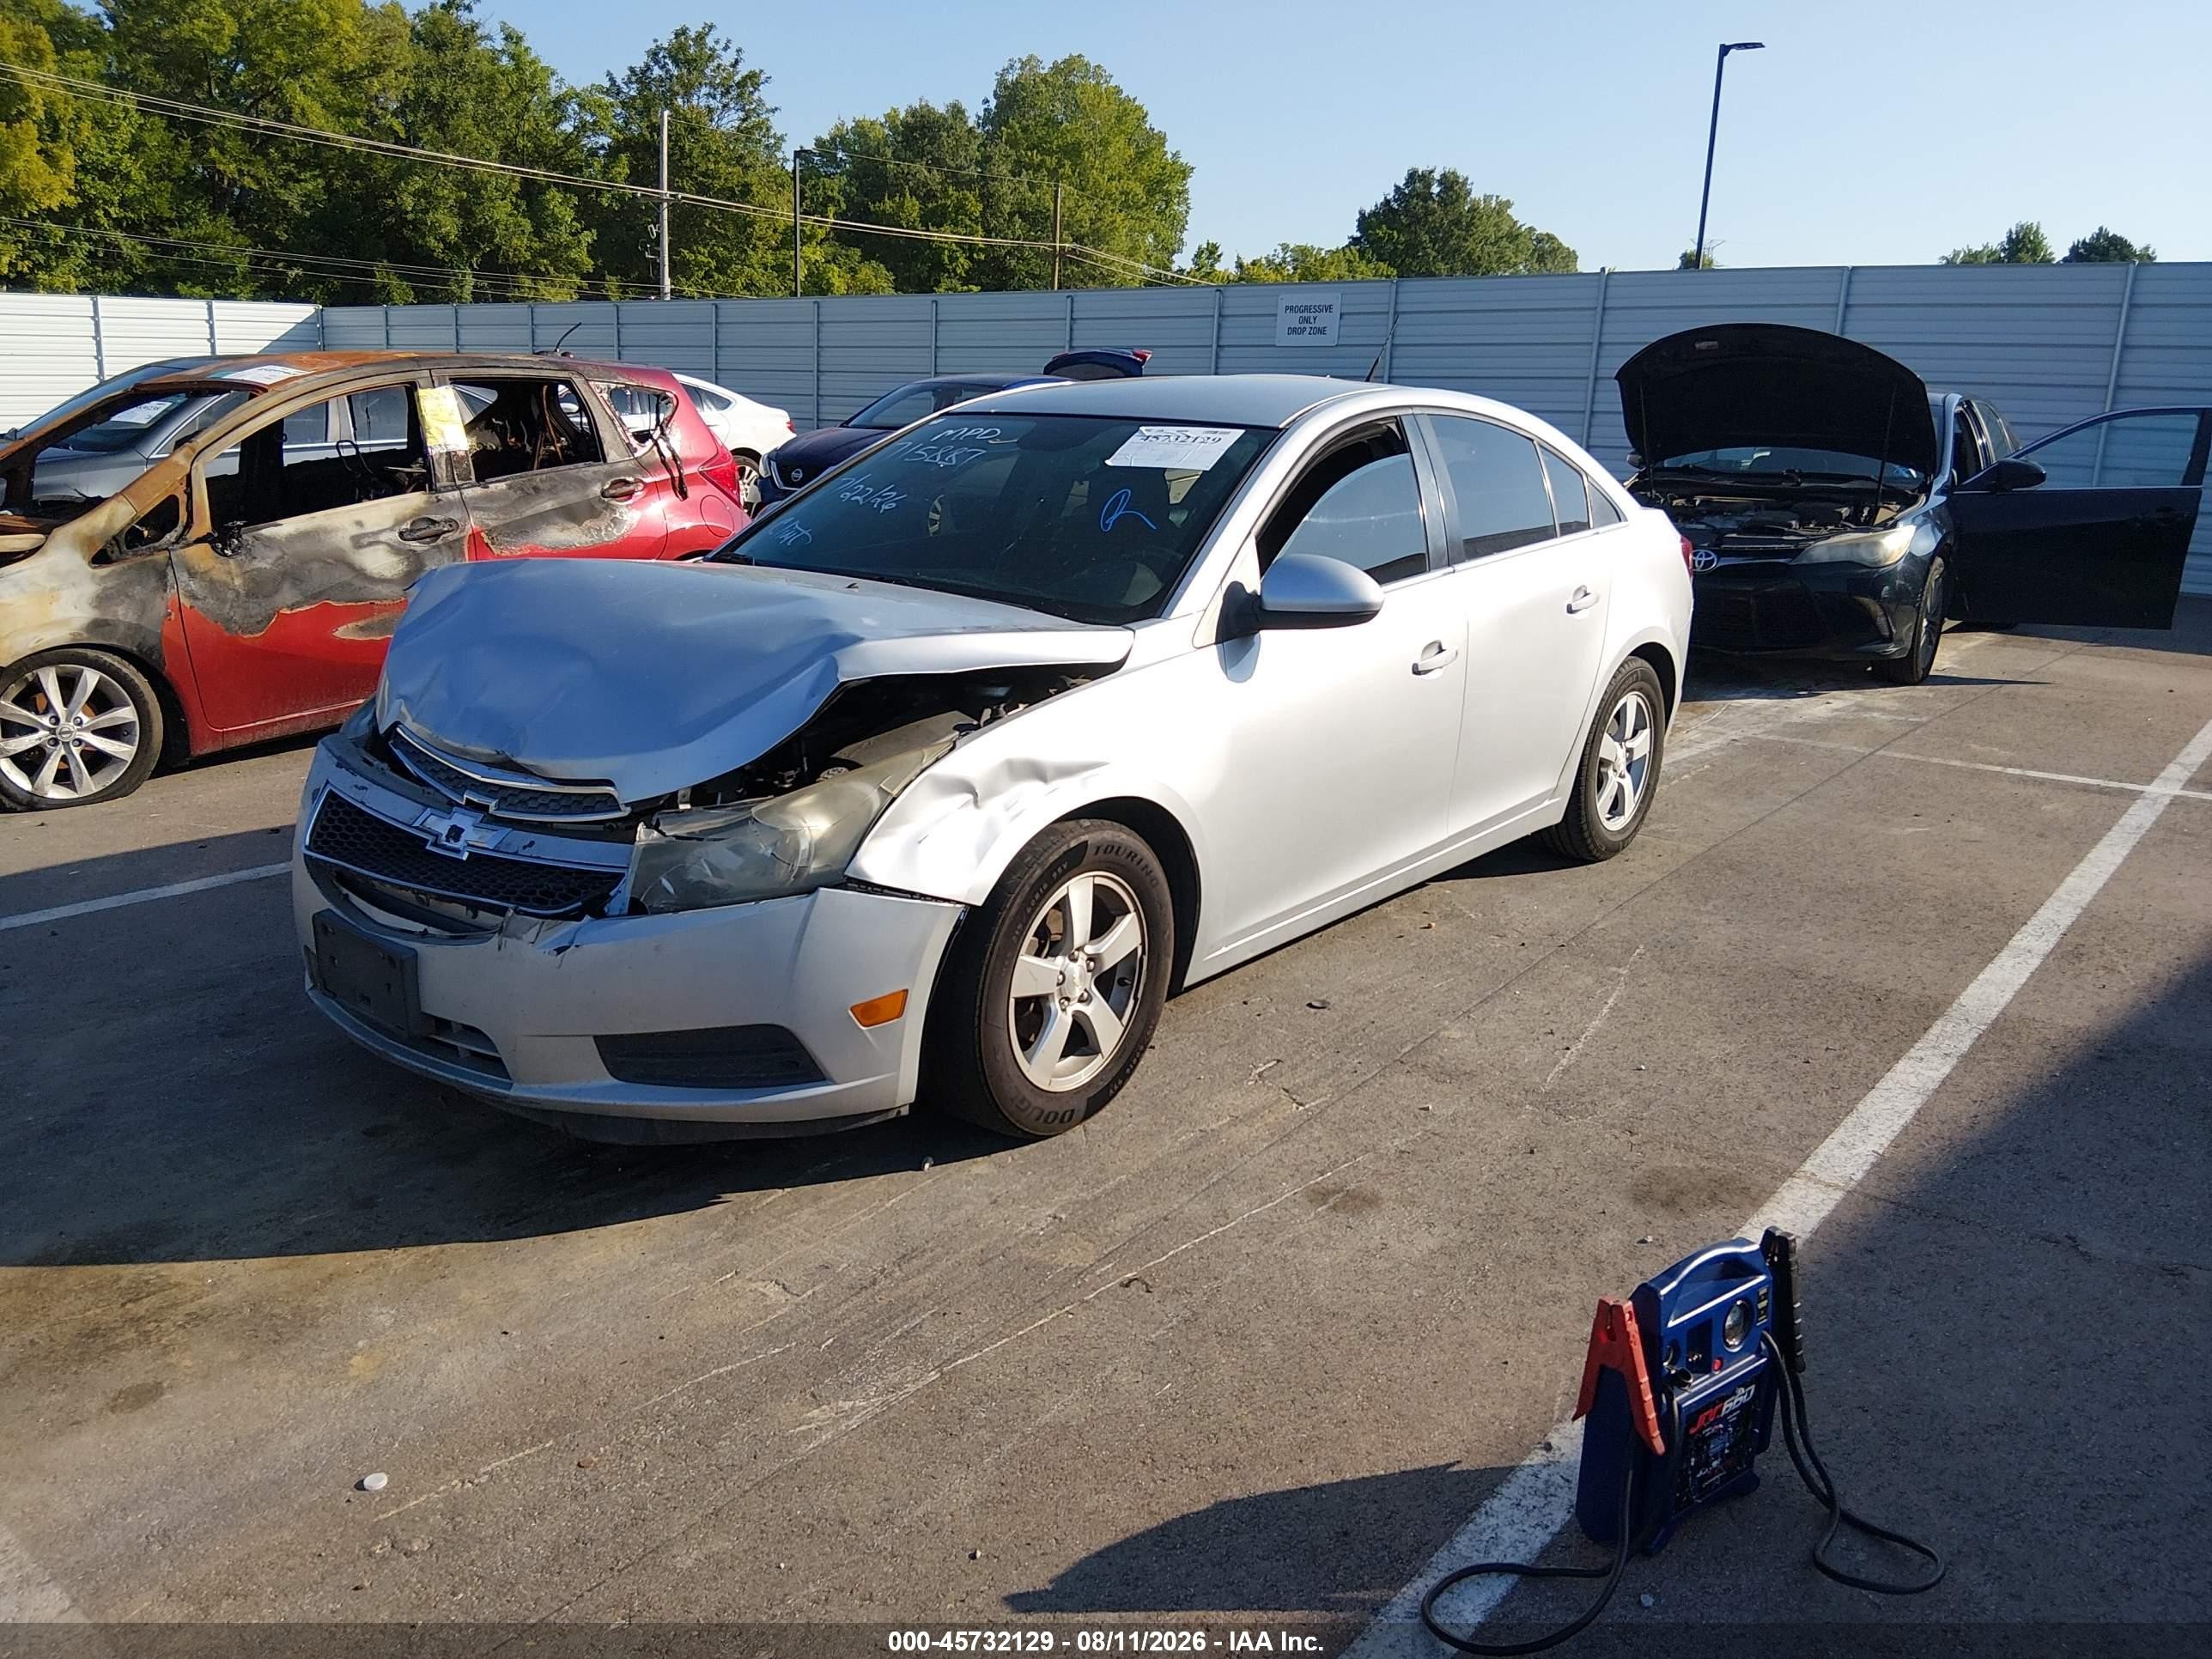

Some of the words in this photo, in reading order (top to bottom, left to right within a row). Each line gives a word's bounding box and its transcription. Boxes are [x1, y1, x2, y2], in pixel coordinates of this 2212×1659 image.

[1284, 304, 1334, 314] PROGRESSIVE
[1298, 315, 1317, 325] ONLY
[1287, 326, 1307, 336] DROP
[1308, 326, 1328, 336] ZONE
[1092, 843, 1159, 890] TOURING
